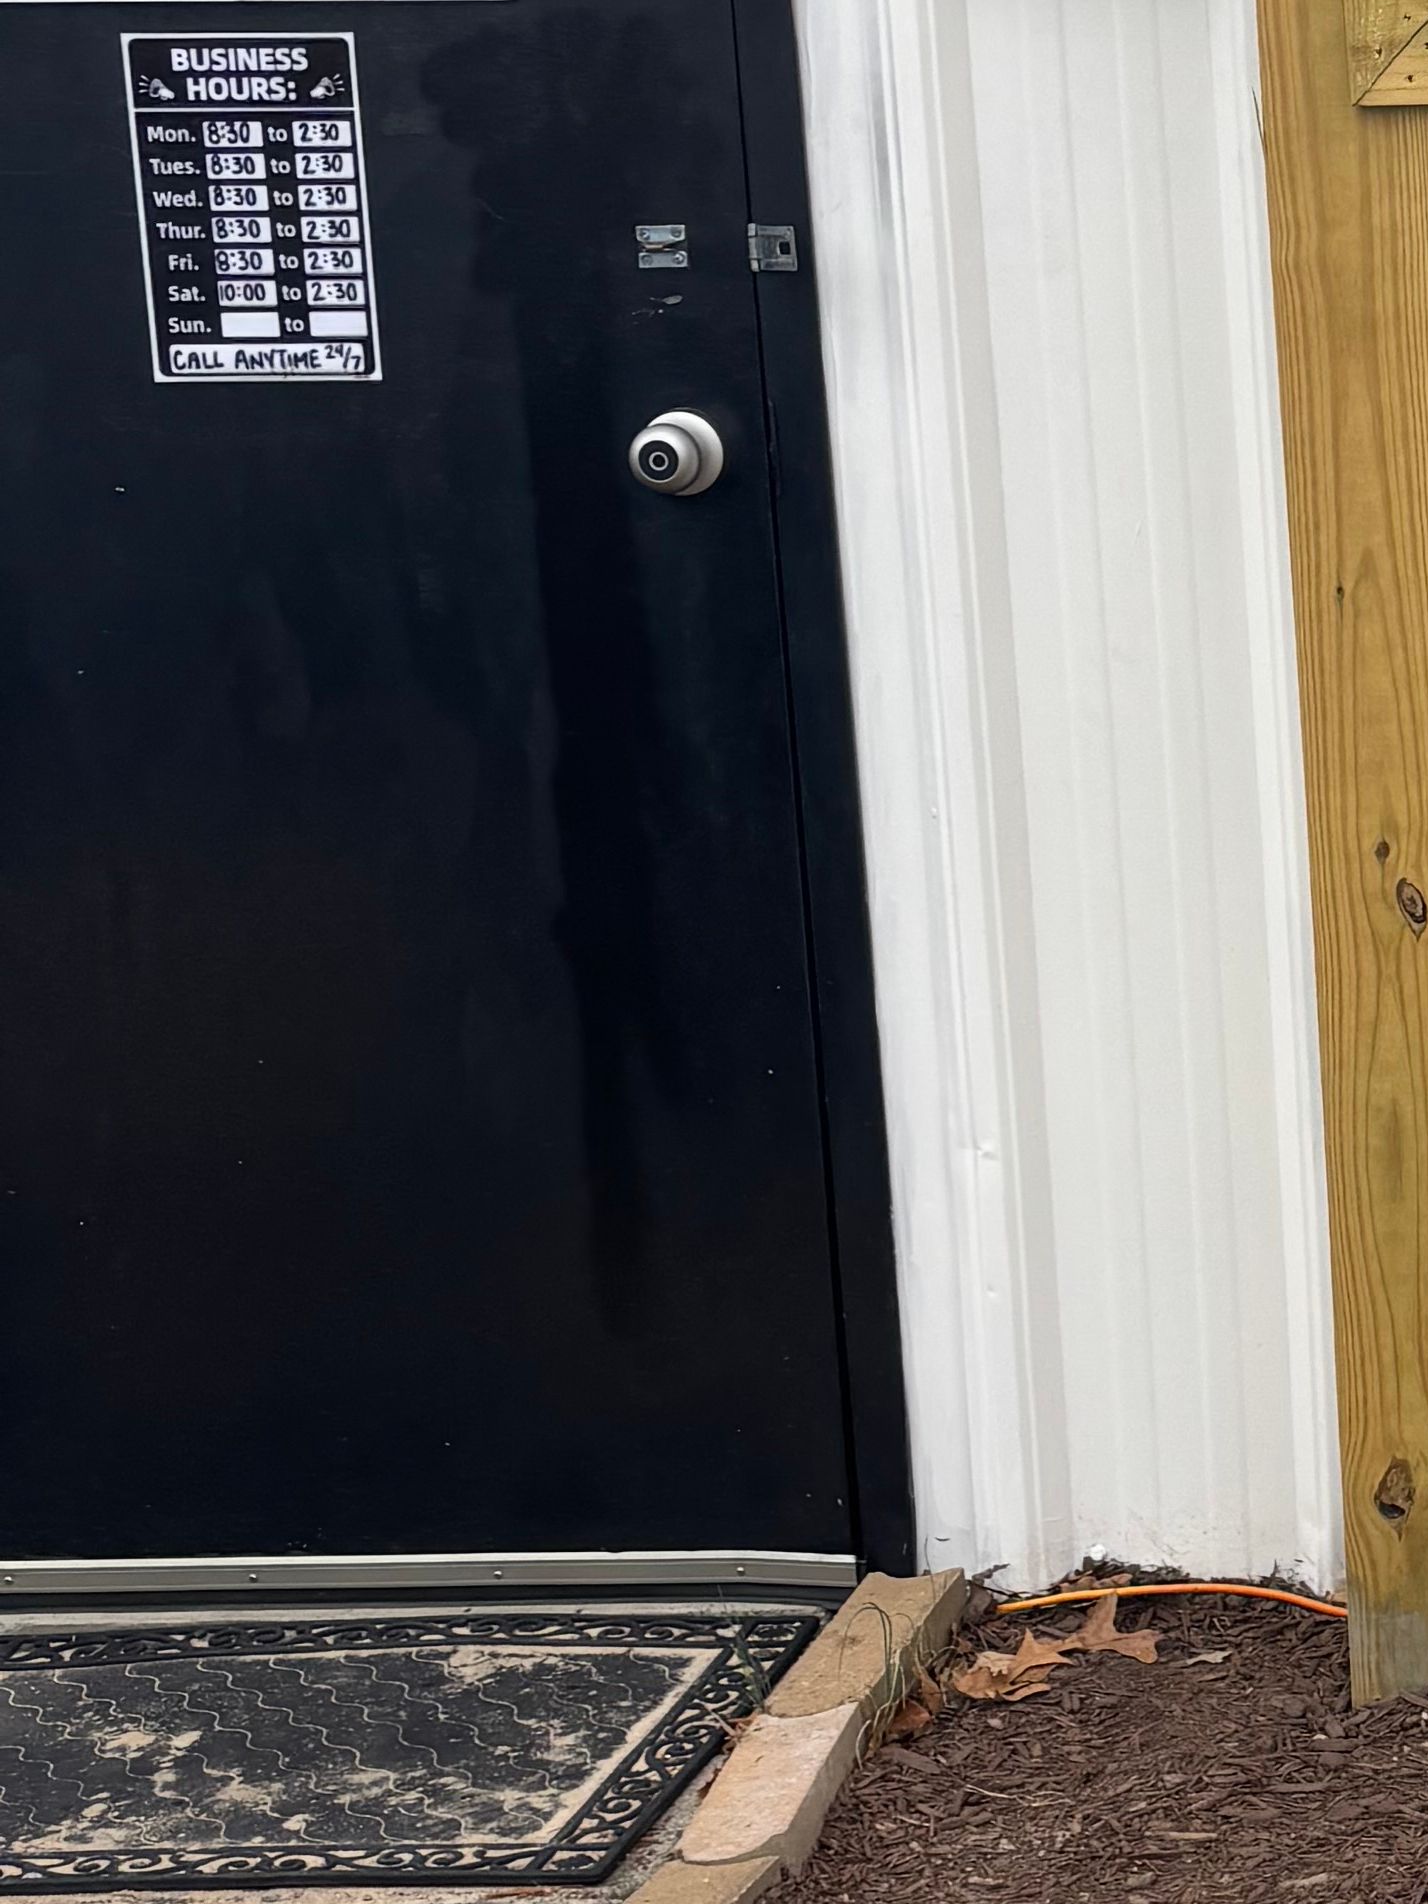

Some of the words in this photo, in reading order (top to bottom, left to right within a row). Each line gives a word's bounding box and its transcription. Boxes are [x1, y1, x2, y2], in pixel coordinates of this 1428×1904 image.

[171, 48, 308, 72] BUSINESS
[186, 77, 297, 101] HOURS:
[147, 126, 196, 142] Mon.
[268, 126, 288, 142] to
[299, 123, 339, 143] 2:30
[149, 158, 201, 175] Tues.
[211, 155, 255, 175] 8:30
[270, 158, 291, 174] to
[302, 154, 343, 174] 2:30
[152, 190, 203, 208] Wed.
[213, 187, 257, 207] 8:30
[273, 190, 293, 207] to
[303, 187, 347, 207] 2:30
[156, 222, 206, 239] Thur.
[216, 219, 261, 238] 8:30
[276, 222, 296, 238] to
[307, 219, 351, 239] 2:30
[168, 254, 199, 271] Fri.
[215, 250, 262, 272] 8:30
[278, 254, 299, 269] to
[308, 251, 353, 271] 2:30
[168, 285, 206, 302] Sat.
[219, 283, 266, 302] 10:00
[281, 285, 301, 301] to
[311, 282, 357, 301] 2:30
[168, 316, 211, 334] Sun.
[284, 316, 304, 333] to
[173, 350, 224, 370] CALL
[235, 349, 322, 370] ANYTIME
[325, 344, 361, 370] 24/7
